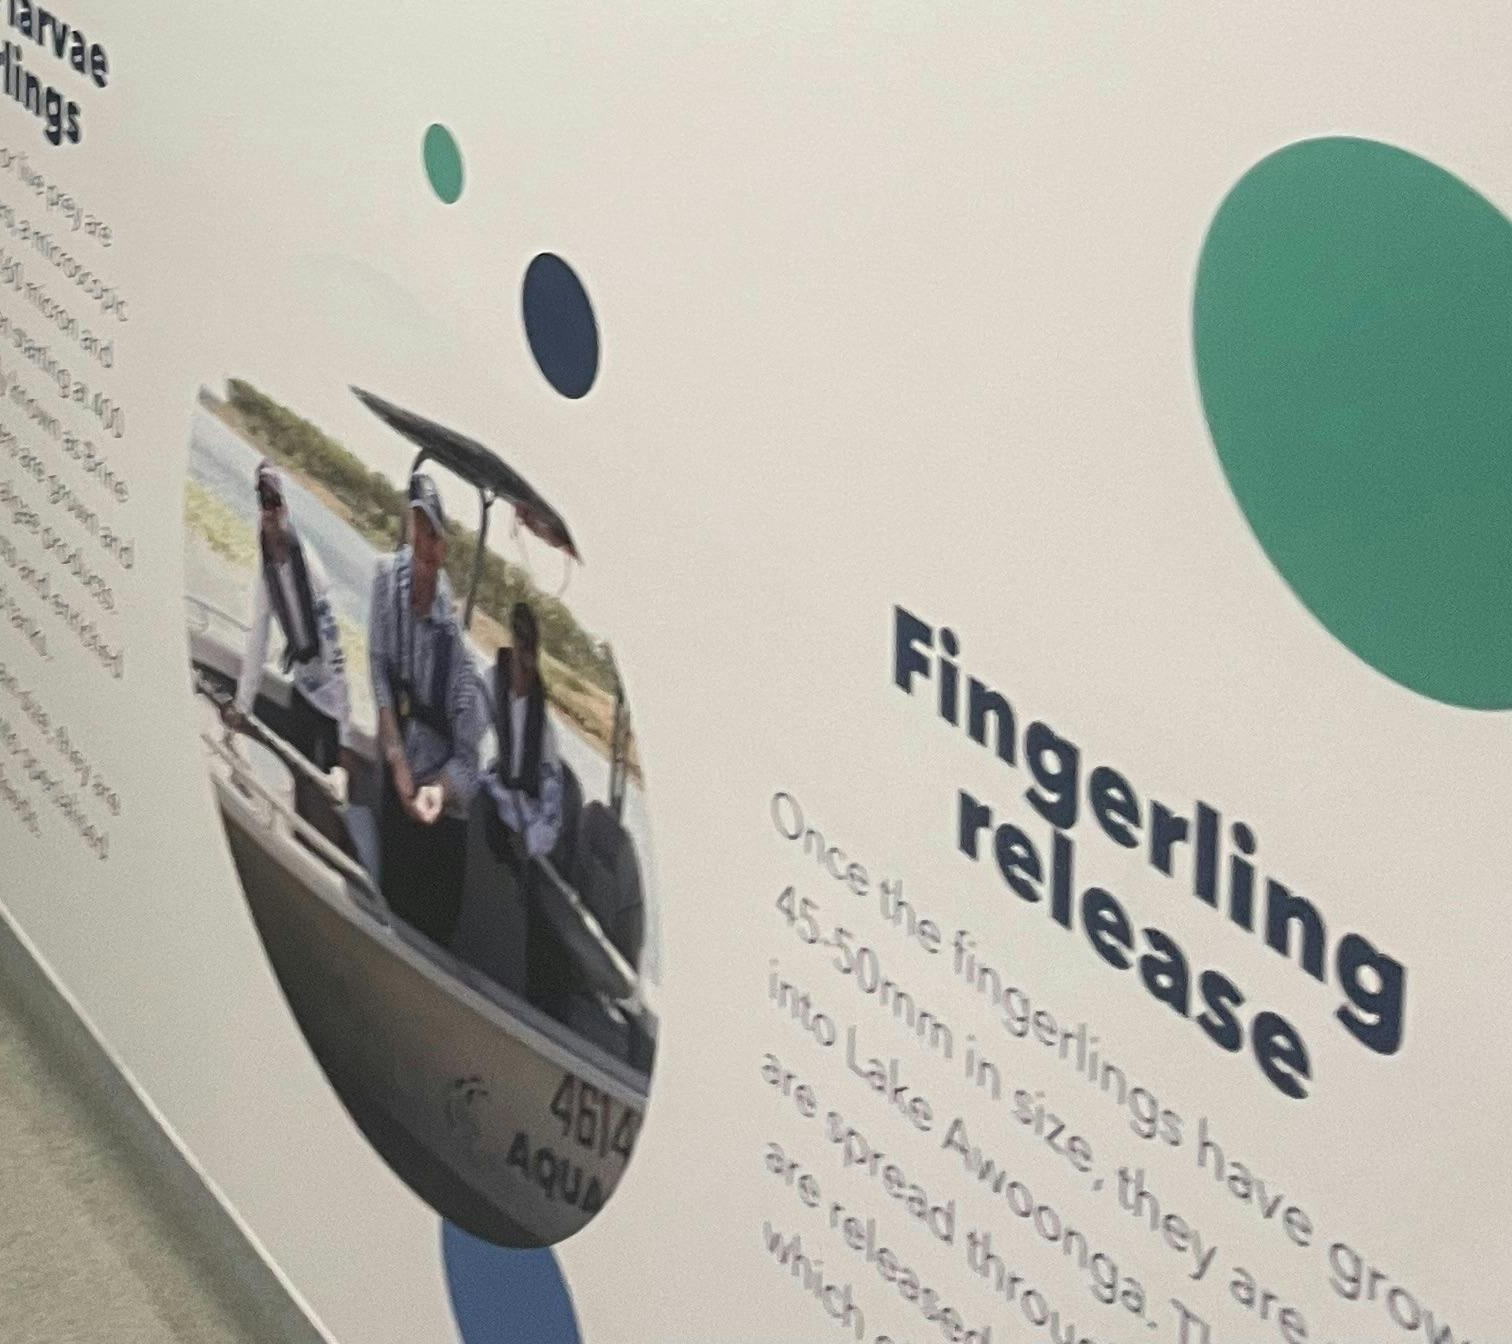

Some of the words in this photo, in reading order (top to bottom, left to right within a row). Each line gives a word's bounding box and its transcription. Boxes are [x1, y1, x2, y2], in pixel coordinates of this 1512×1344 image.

[890, 604, 1408, 1056] Fingerling
[956, 790, 1315, 1101] release
[767, 957, 838, 1049] into
[846, 1023, 936, 1133] Lake
[769, 790, 870, 897] Once
[879, 877, 942, 955] the
[953, 928, 1184, 1148] fingerlings
[1196, 1115, 1314, 1249] have
[774, 884, 954, 1060] 45-50mm
[964, 1032, 1003, 1102] in
[1116, 1165, 1219, 1282] they
[1229, 1266, 1310, 1344] are
[760, 1051, 818, 1120] are
[823, 1110, 957, 1246] spread
[764, 1140, 821, 1209] are
[762, 1219, 866, 1342] which
